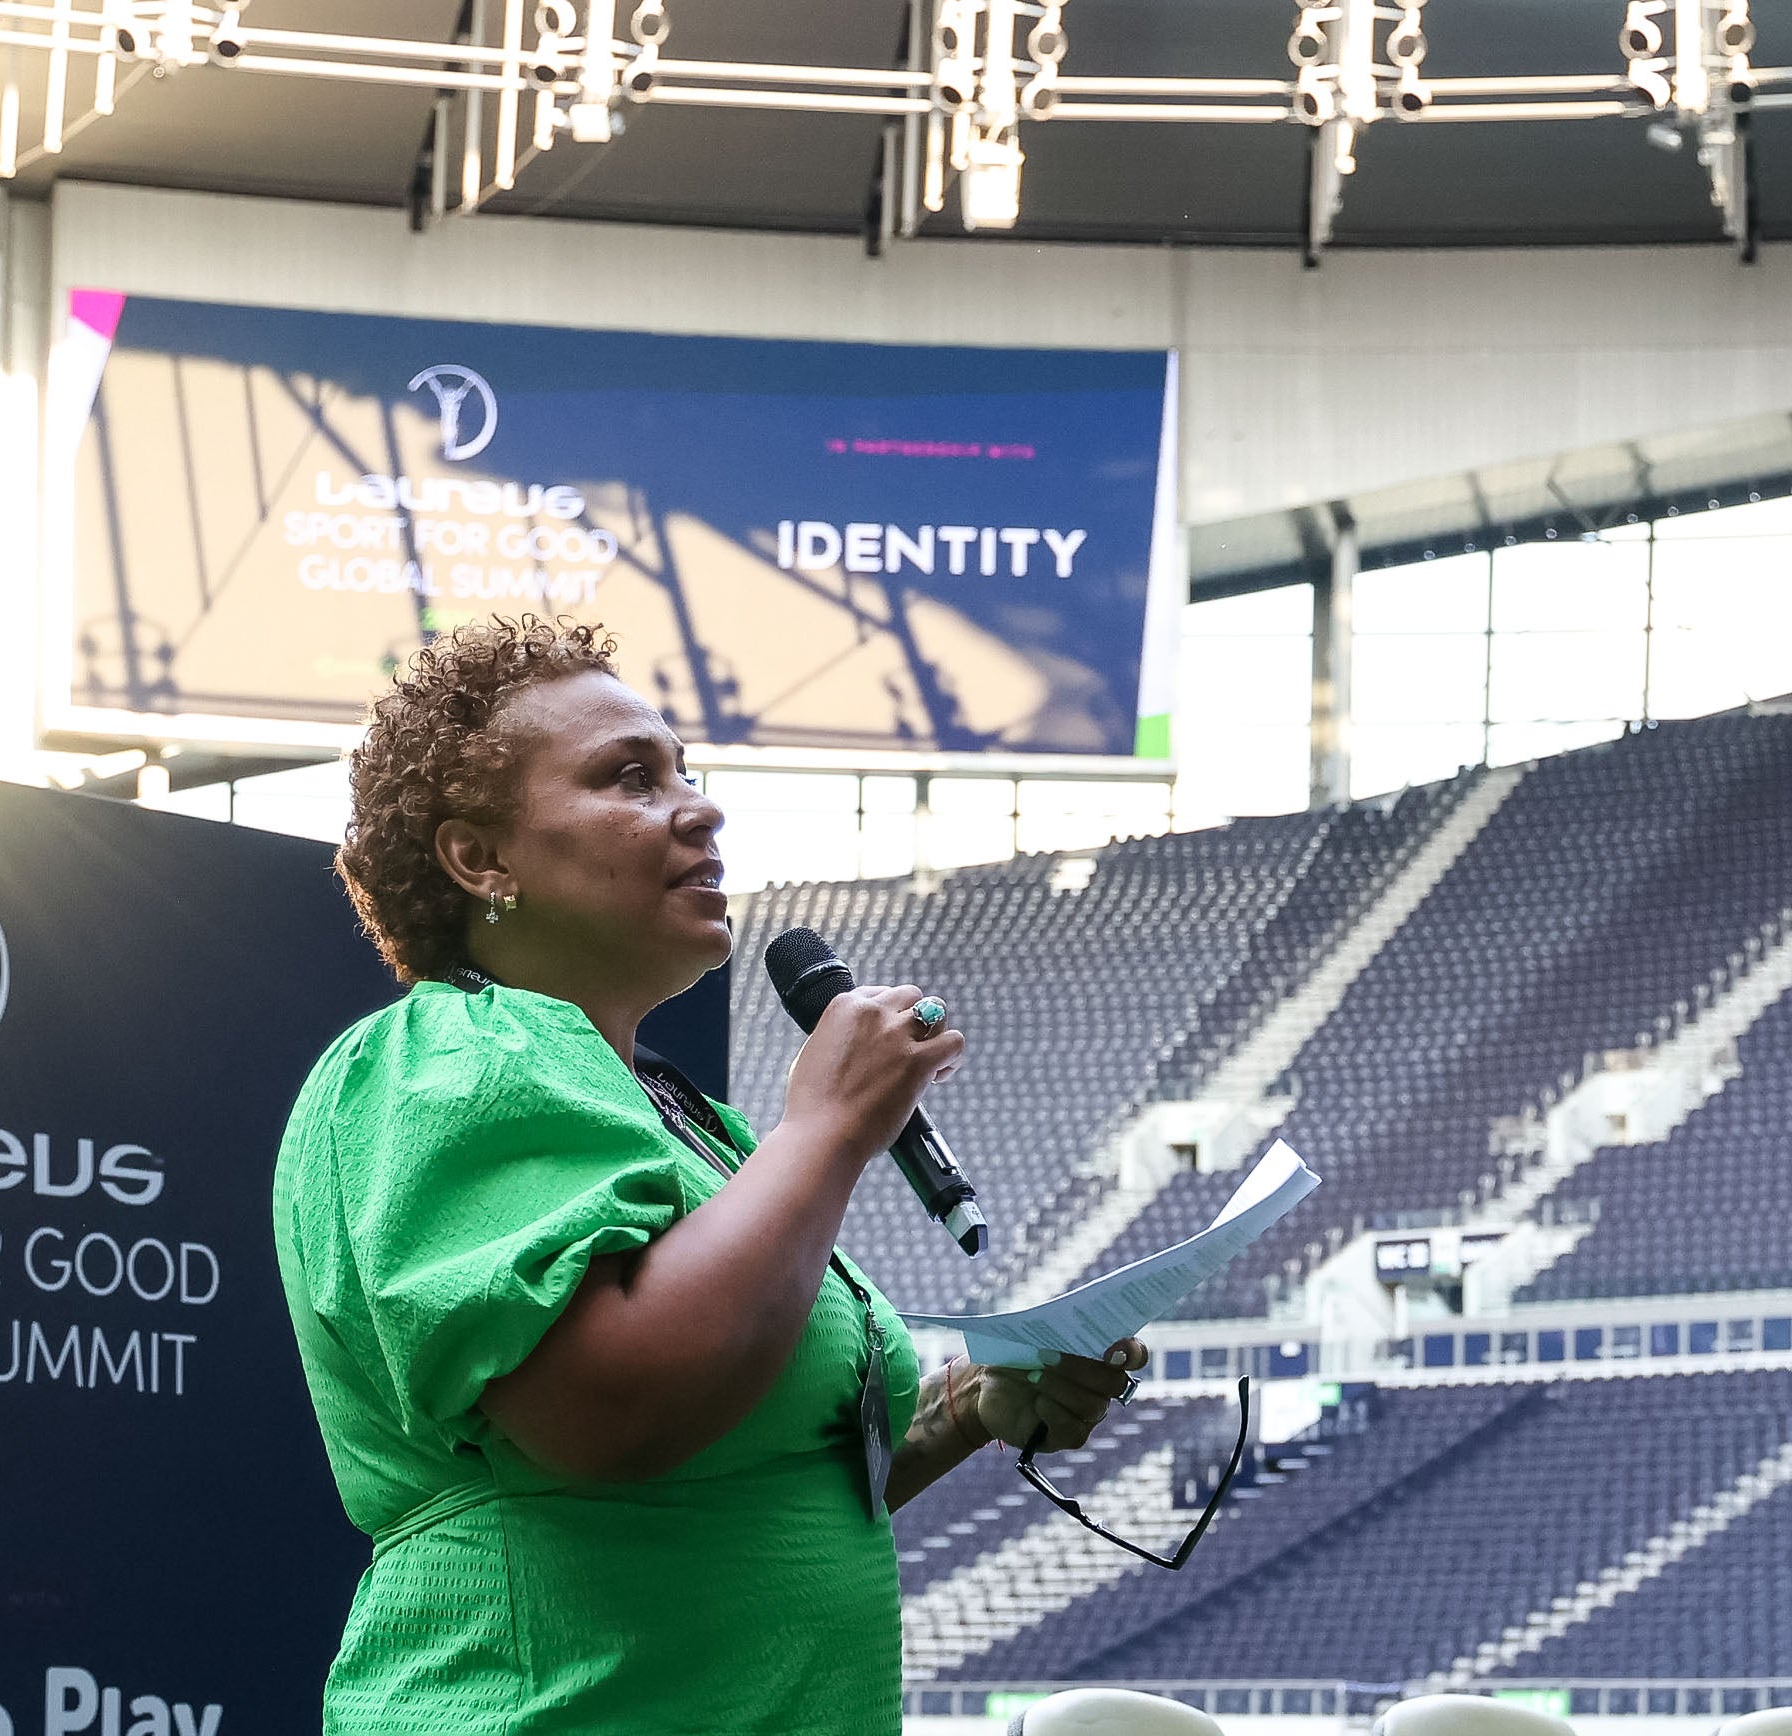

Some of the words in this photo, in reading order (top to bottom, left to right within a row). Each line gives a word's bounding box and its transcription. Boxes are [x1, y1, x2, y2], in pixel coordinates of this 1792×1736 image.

[315, 472, 585, 519] Laureus
[284, 511, 405, 549] SPORT
[414, 521, 490, 556] FOR
[497, 526, 619, 564] GOOD
[777, 519, 1088, 578] IDENTITY
[298, 554, 443, 597] GLOBAL
[449, 564, 603, 605] SUMMIT
[24, 1226, 220, 1305] GOOD
